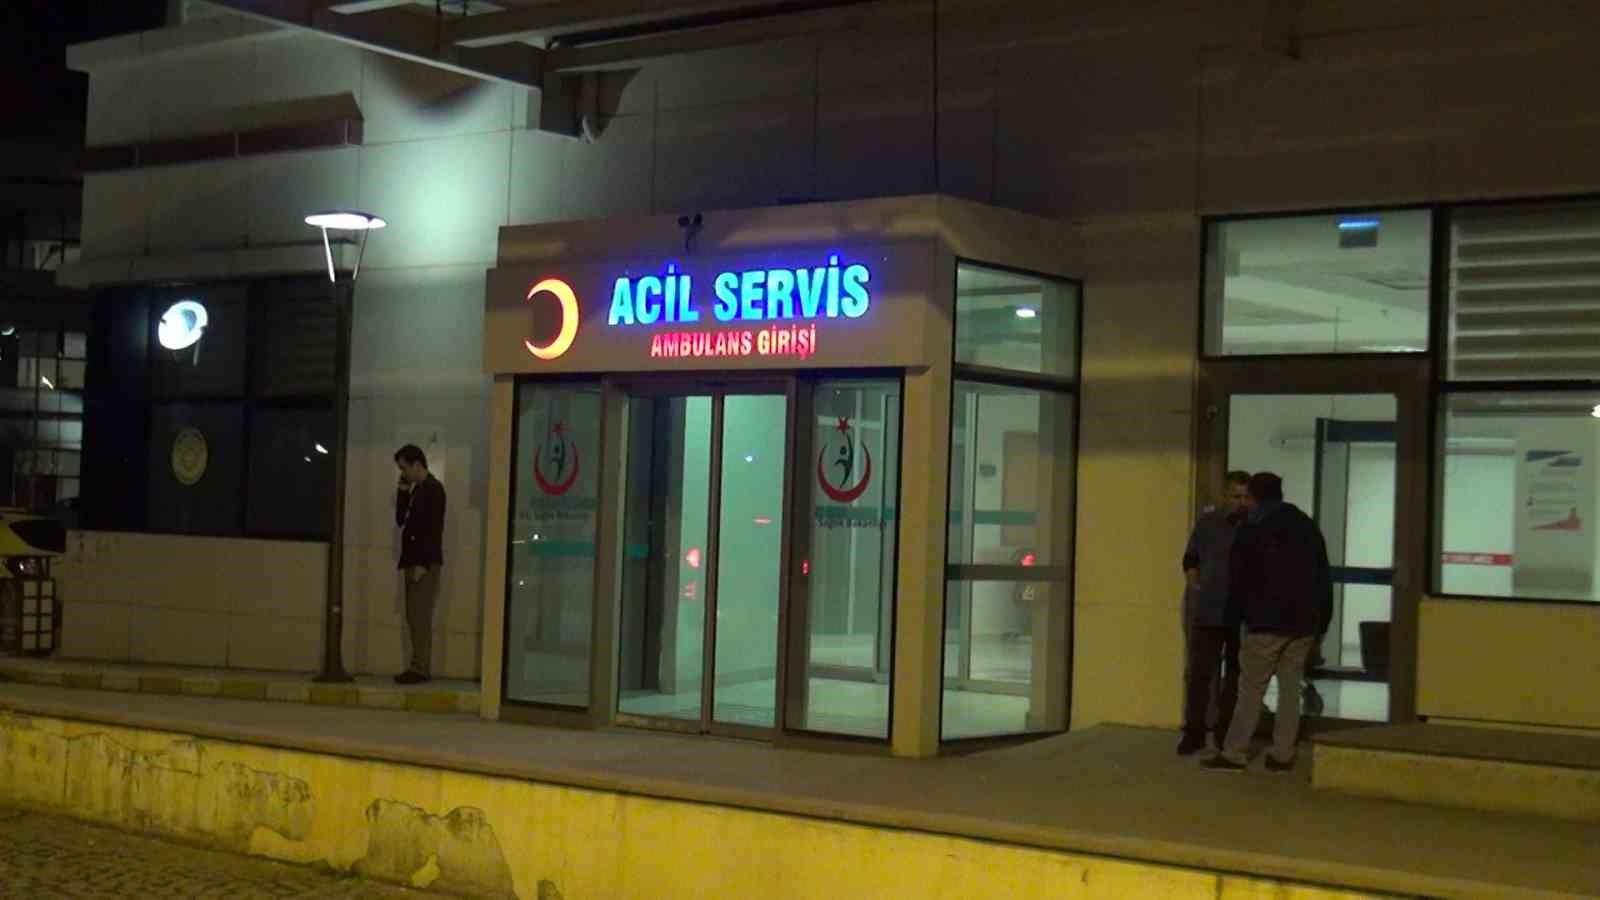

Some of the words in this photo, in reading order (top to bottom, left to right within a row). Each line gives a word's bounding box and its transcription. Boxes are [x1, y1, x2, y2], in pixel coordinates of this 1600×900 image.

[608, 263, 699, 325] ACİL
[714, 255, 870, 321] SERVİS
[651, 332, 753, 358] AMBULANS
[757, 324, 816, 360] GİRİŞİ
